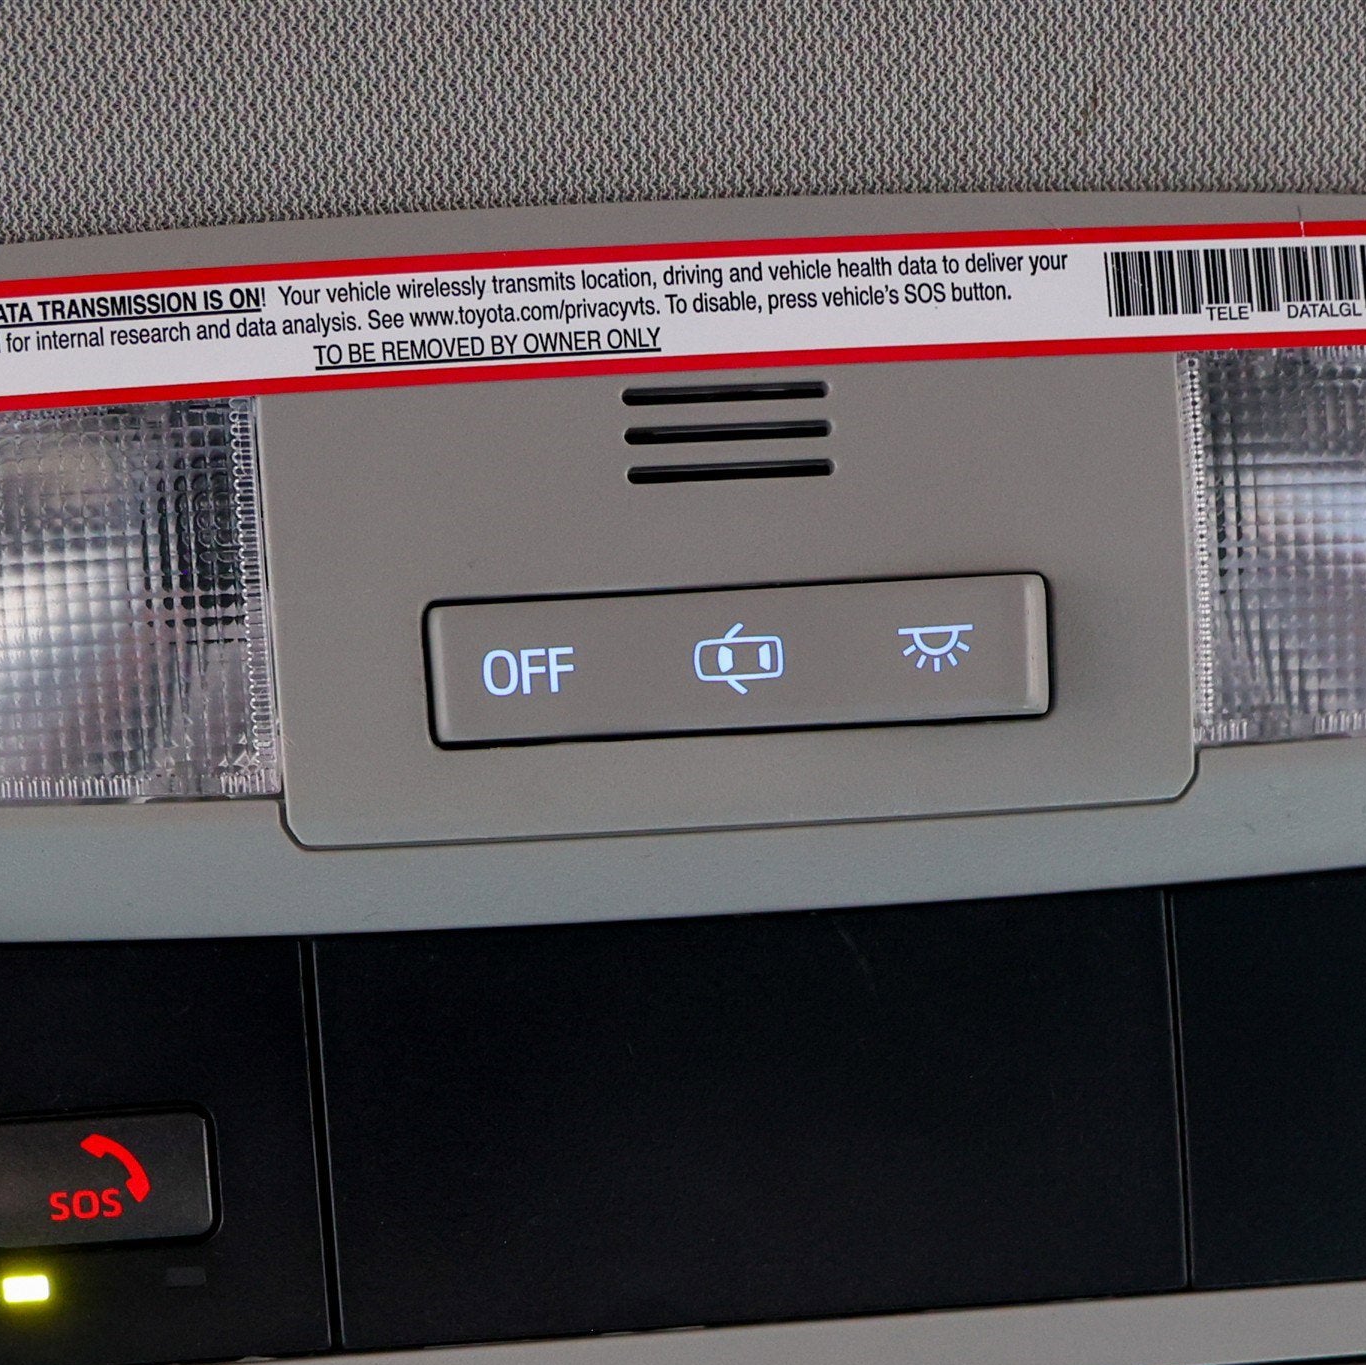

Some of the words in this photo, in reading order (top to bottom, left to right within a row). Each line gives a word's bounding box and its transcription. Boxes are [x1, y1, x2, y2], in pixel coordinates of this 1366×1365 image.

[37, 292, 197, 320] TRANSMISSION
[203, 290, 223, 310] IS
[230, 287, 265, 309] ON!
[278, 286, 320, 305] Your
[326, 281, 390, 302] vehicle
[396, 276, 486, 300] wirelessly
[492, 271, 575, 294] transmits
[581, 269, 656, 289] location,
[663, 264, 723, 288] driving
[730, 262, 762, 282] and
[768, 259, 831, 280] vehicle
[837, 257, 892, 278] health
[898, 256, 937, 275] data
[942, 256, 959, 274] to
[966, 252, 1023, 273] deliver
[1029, 254, 1068, 275] your
[6, 333, 30, 352] for
[37, 327, 104, 350] internal
[111, 322, 190, 345] research
[197, 319, 230, 340] and
[236, 318, 277, 337] data
[283, 311, 361, 337] analysis.
[368, 310, 404, 329] See
[409, 297, 660, 329] www.toyota.com/privacyvts.
[665, 294, 687, 314] To
[693, 291, 762, 313] disable,
[768, 293, 817, 314] press
[905, 282, 946, 304] SOS
[951, 282, 1011, 302] button.
[1206, 305, 1250, 321] TELE
[1287, 302, 1362, 319] DATALGL
[313, 344, 342, 365] TO
[348, 343, 376, 363] BE
[382, 337, 484, 361] REMOVED
[491, 335, 517, 355] BY
[524, 331, 601, 353] OWNER
[607, 327, 660, 349] ONLY
[482, 646, 575, 697] OFF
[49, 1187, 123, 1221] SOS
